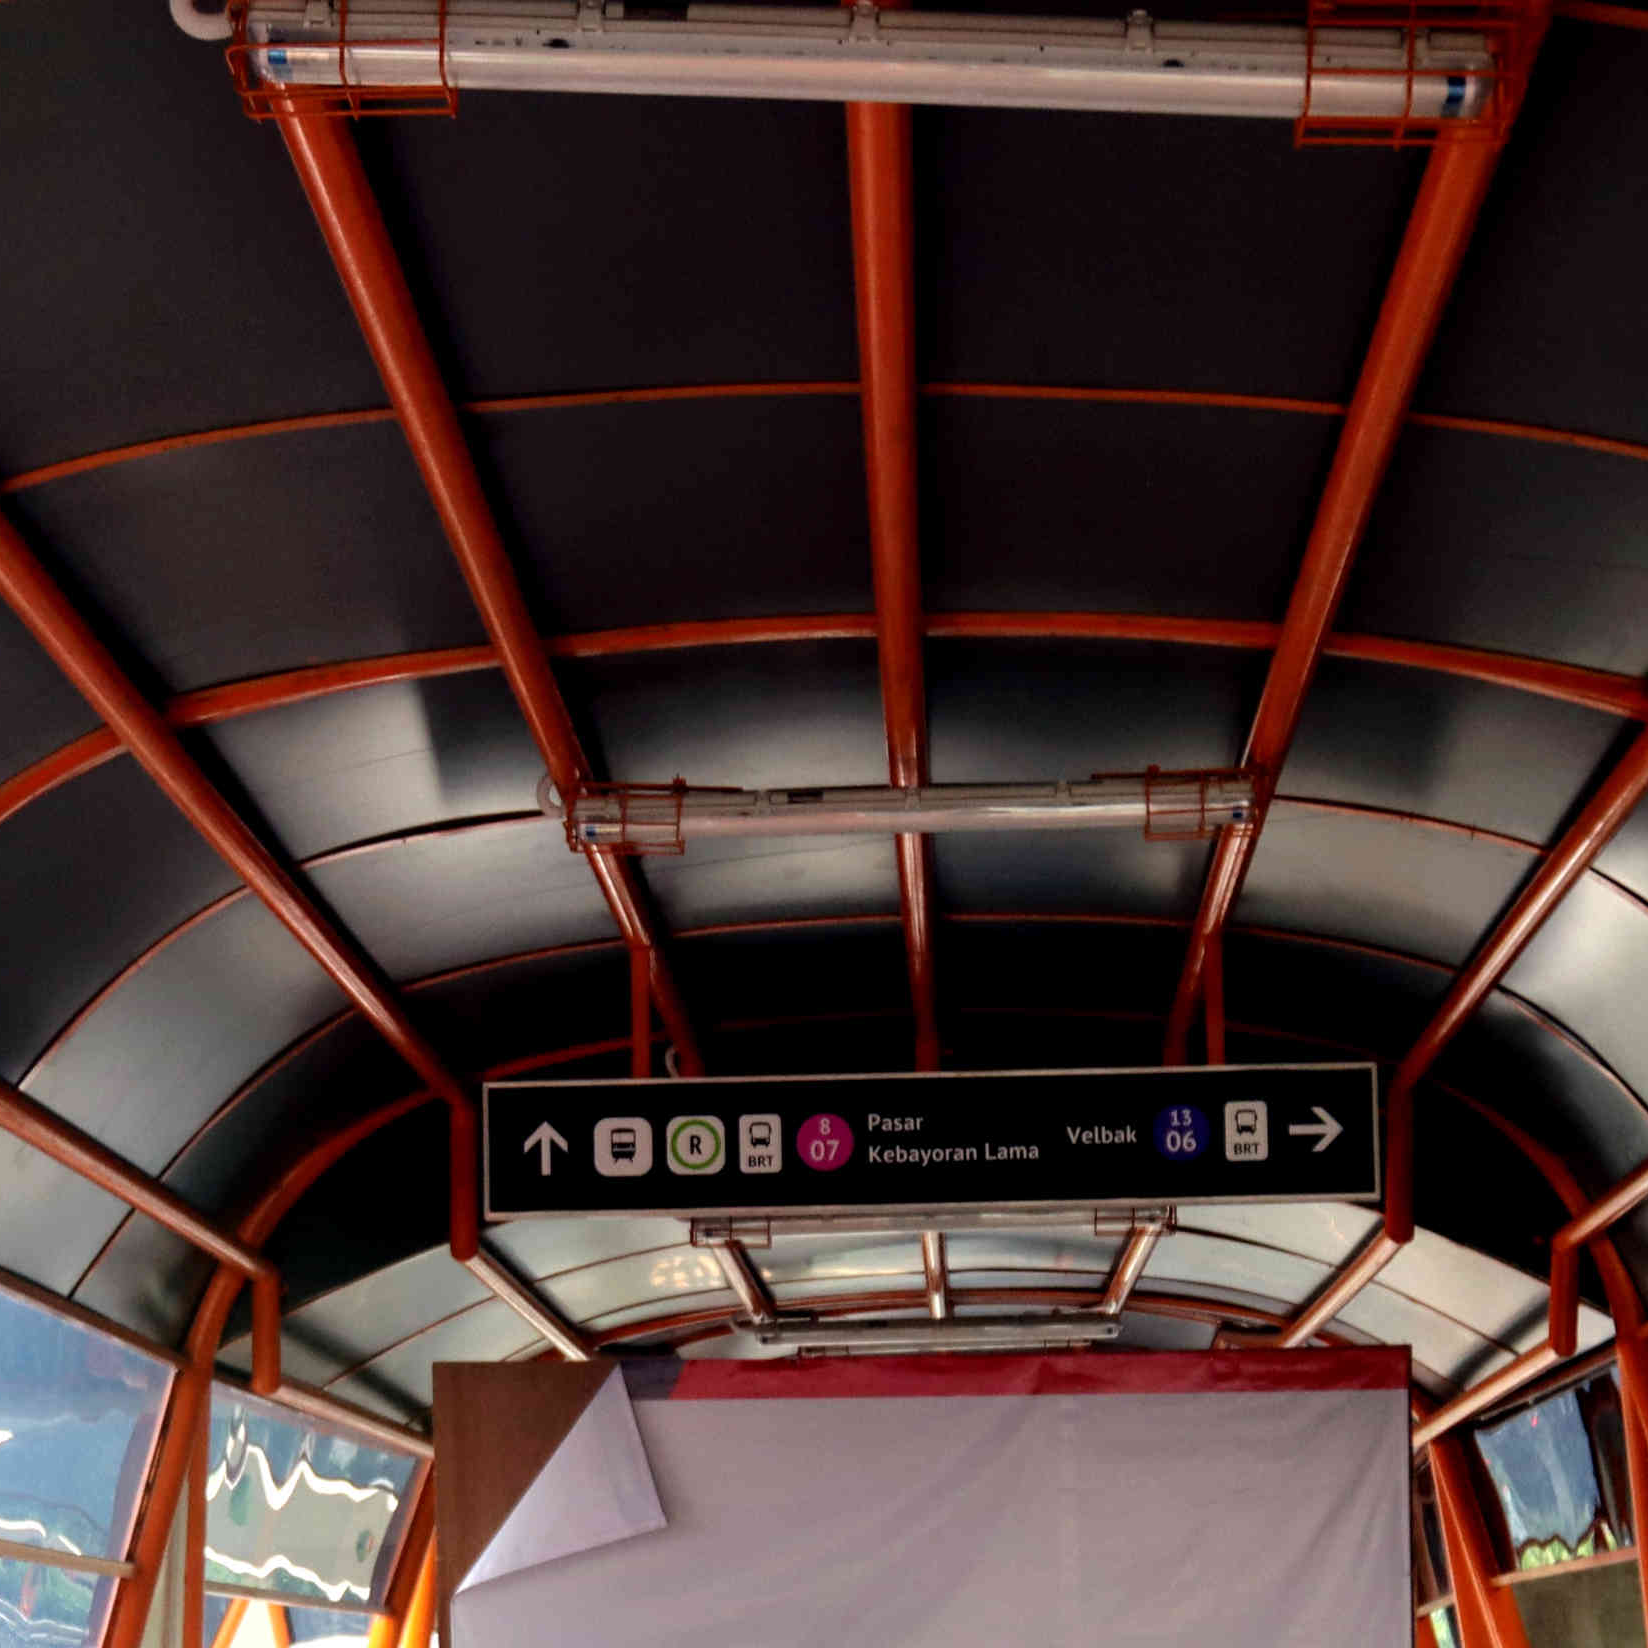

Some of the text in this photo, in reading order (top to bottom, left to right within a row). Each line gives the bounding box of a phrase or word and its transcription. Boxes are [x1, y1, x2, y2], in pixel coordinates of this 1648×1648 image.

[818, 1117, 832, 1136] 8
[867, 1113, 924, 1132] Pasar
[1169, 1108, 1193, 1127] 13
[1066, 1125, 1138, 1145] Velbak
[1166, 1130, 1197, 1153] 06
[689, 1135, 703, 1155] R
[809, 1139, 840, 1162] 07
[868, 1142, 1040, 1167] Kebayoran Lama
[1233, 1143, 1261, 1155] BRT
[748, 1155, 774, 1168] BRT
